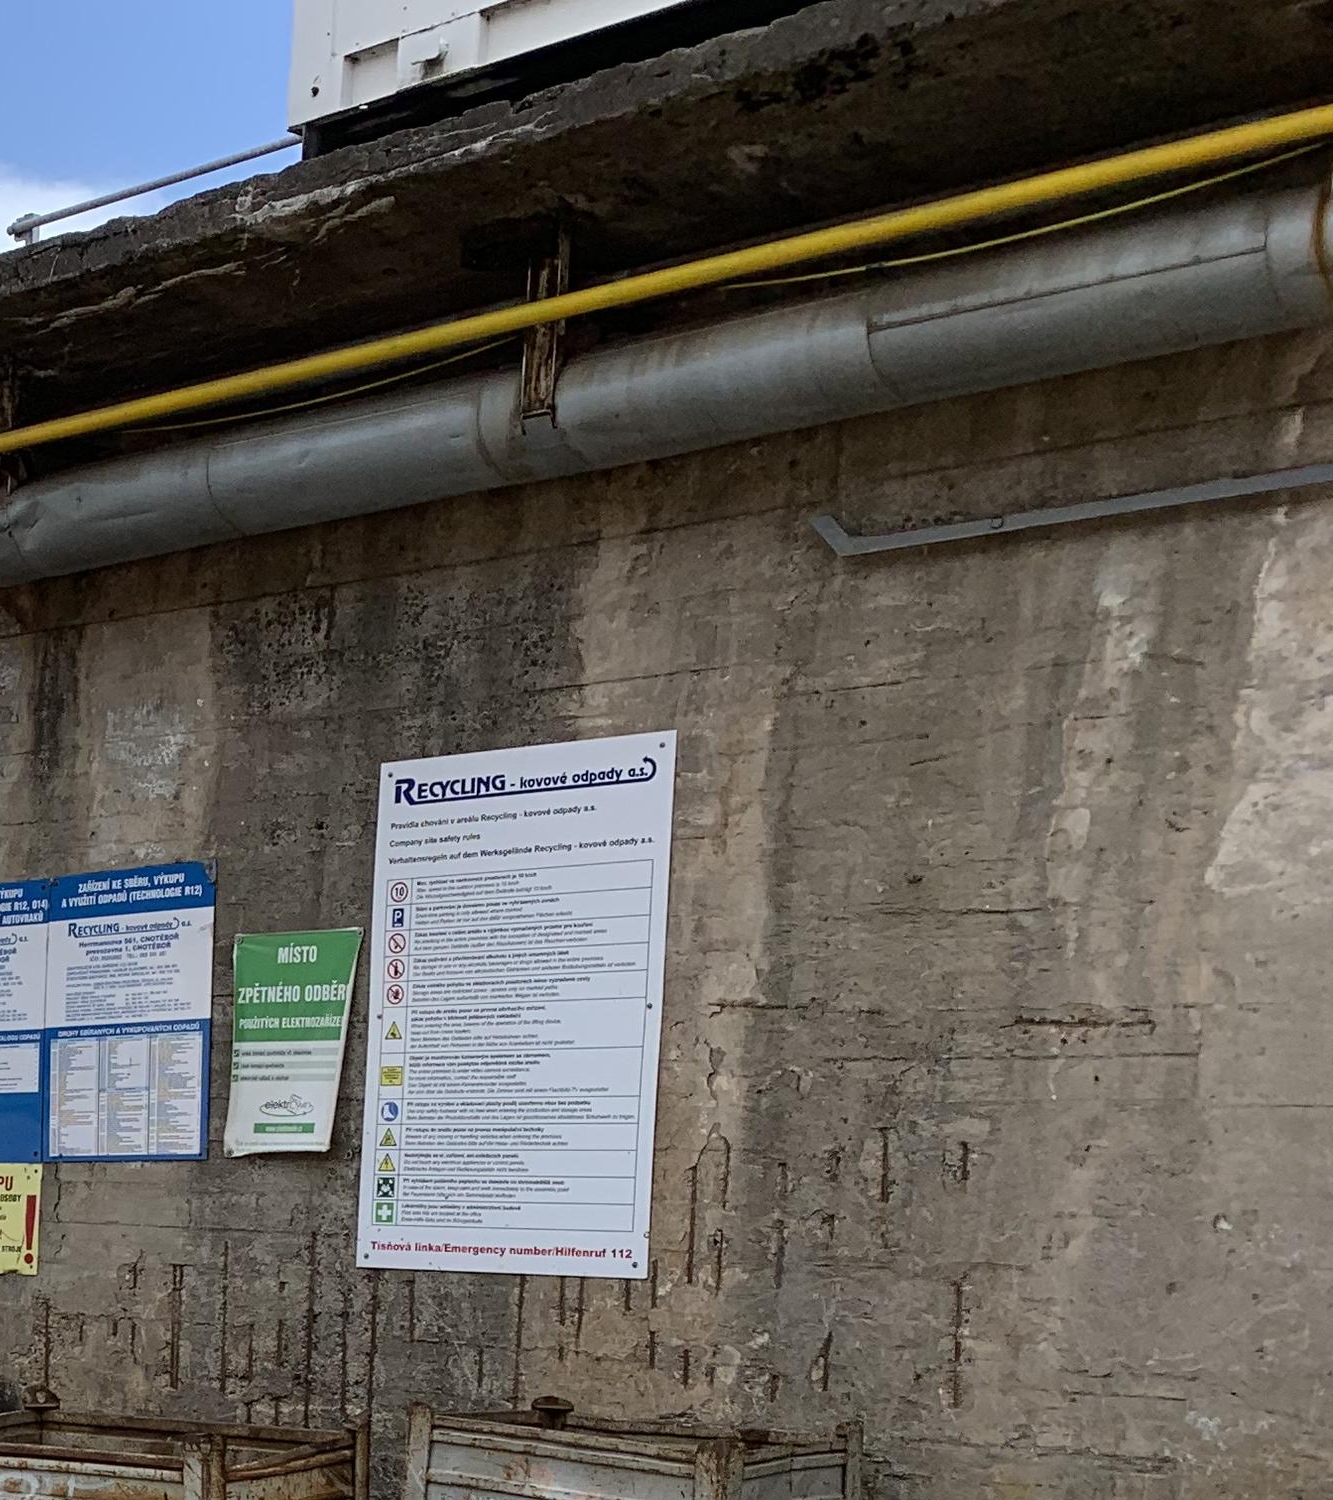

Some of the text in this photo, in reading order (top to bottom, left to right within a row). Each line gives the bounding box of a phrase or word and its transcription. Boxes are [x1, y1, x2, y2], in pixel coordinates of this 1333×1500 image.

[394, 774, 506, 806] RECYCLING
[520, 772, 568, 790] kovové
[572, 767, 623, 786] odpady
[628, 765, 648, 778] a.s.
[481, 811, 517, 822] Recycling
[524, 808, 551, 817] kovové
[553, 806, 581, 816] odpady
[389, 838, 423, 848] Company
[535, 842, 572, 854] Recycling
[579, 839, 607, 849] kovové
[609, 836, 638, 848] odpady
[78, 872, 185, 894] ZAŘÍZENÍ KE SBĚRU, VÝKUPU
[61, 884, 203, 908] A VYUŽITÍ ODPADŮ (TECHNOLOGIE R12)
[68, 922, 120, 938] RECYCLING
[277, 943, 317, 964] MÍSTO
[238, 980, 351, 1004] ZPĚTNÉHO ODBĚR
[239, 1014, 344, 1030] POUŽITÝCH ELEKTROZAŘÍZE
[611, 1249, 633, 1258] 112
